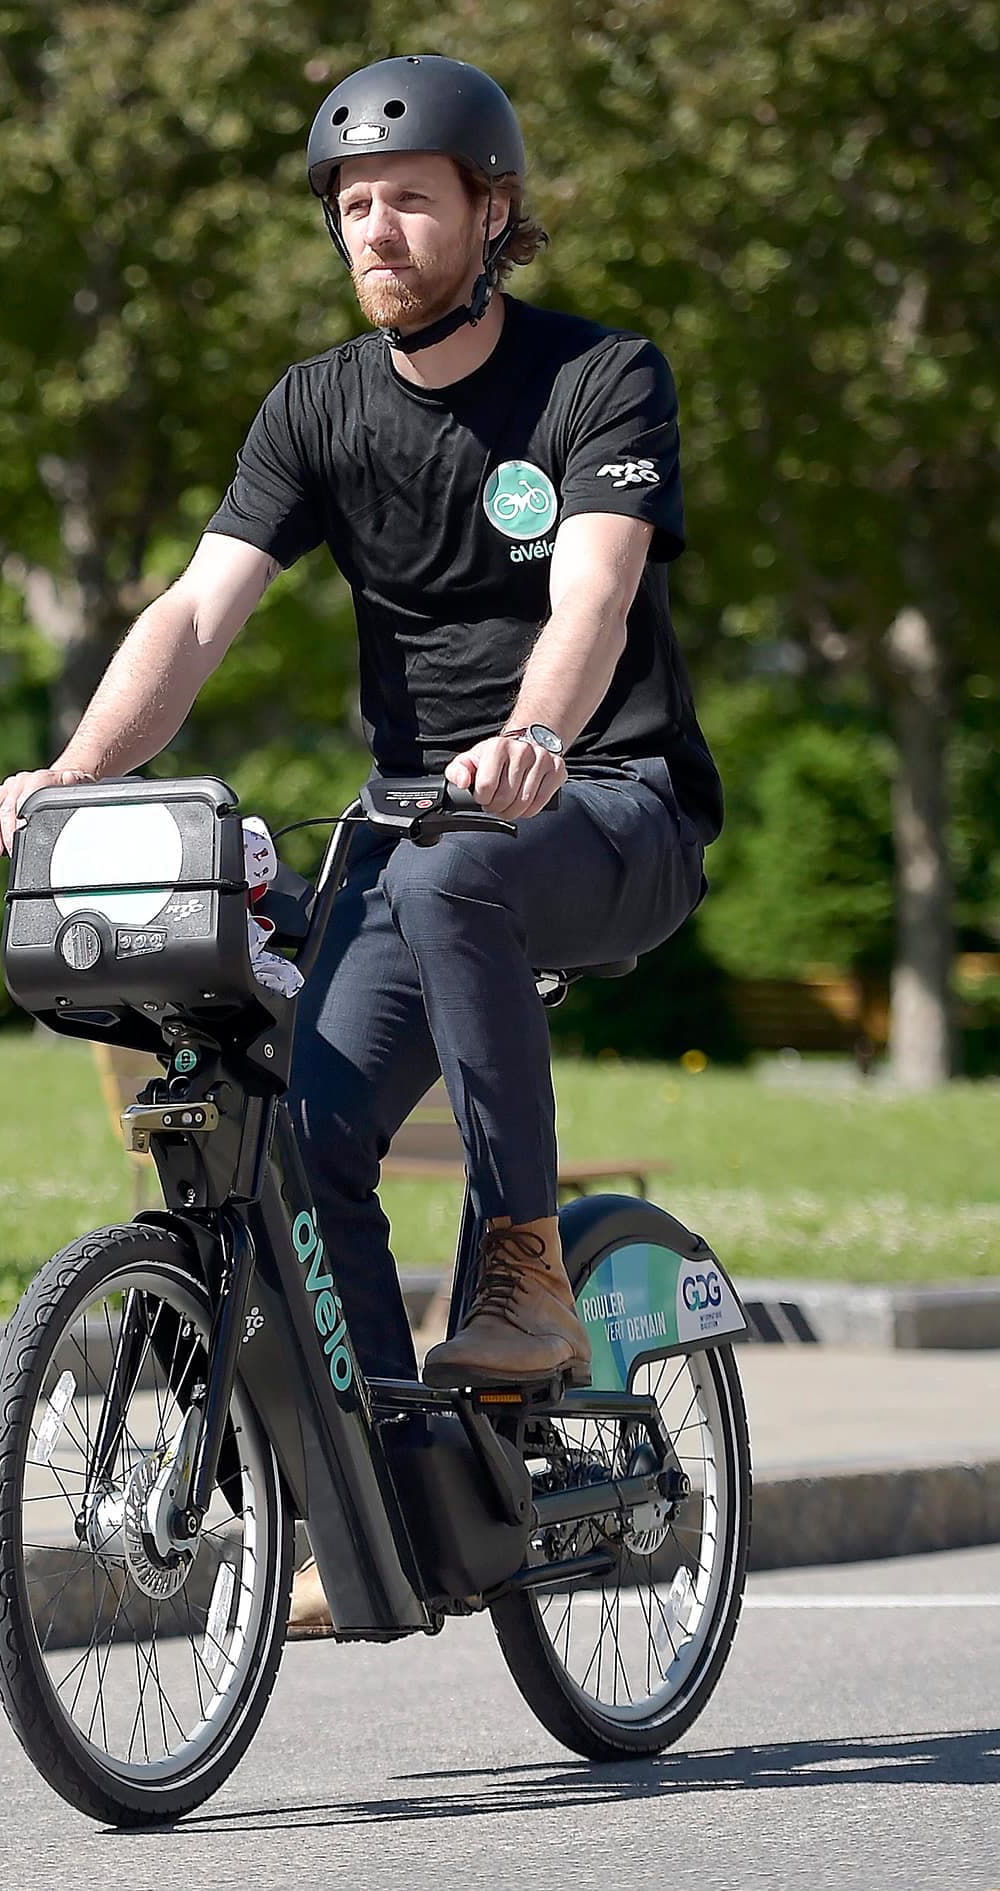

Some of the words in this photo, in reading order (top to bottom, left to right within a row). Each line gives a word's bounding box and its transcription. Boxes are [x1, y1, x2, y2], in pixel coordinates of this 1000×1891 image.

[582, 1291, 626, 1322] ROULER
[683, 1271, 722, 1311] GDG
[604, 1319, 626, 1342] VERT
[626, 1311, 667, 1341] DEMAIN
